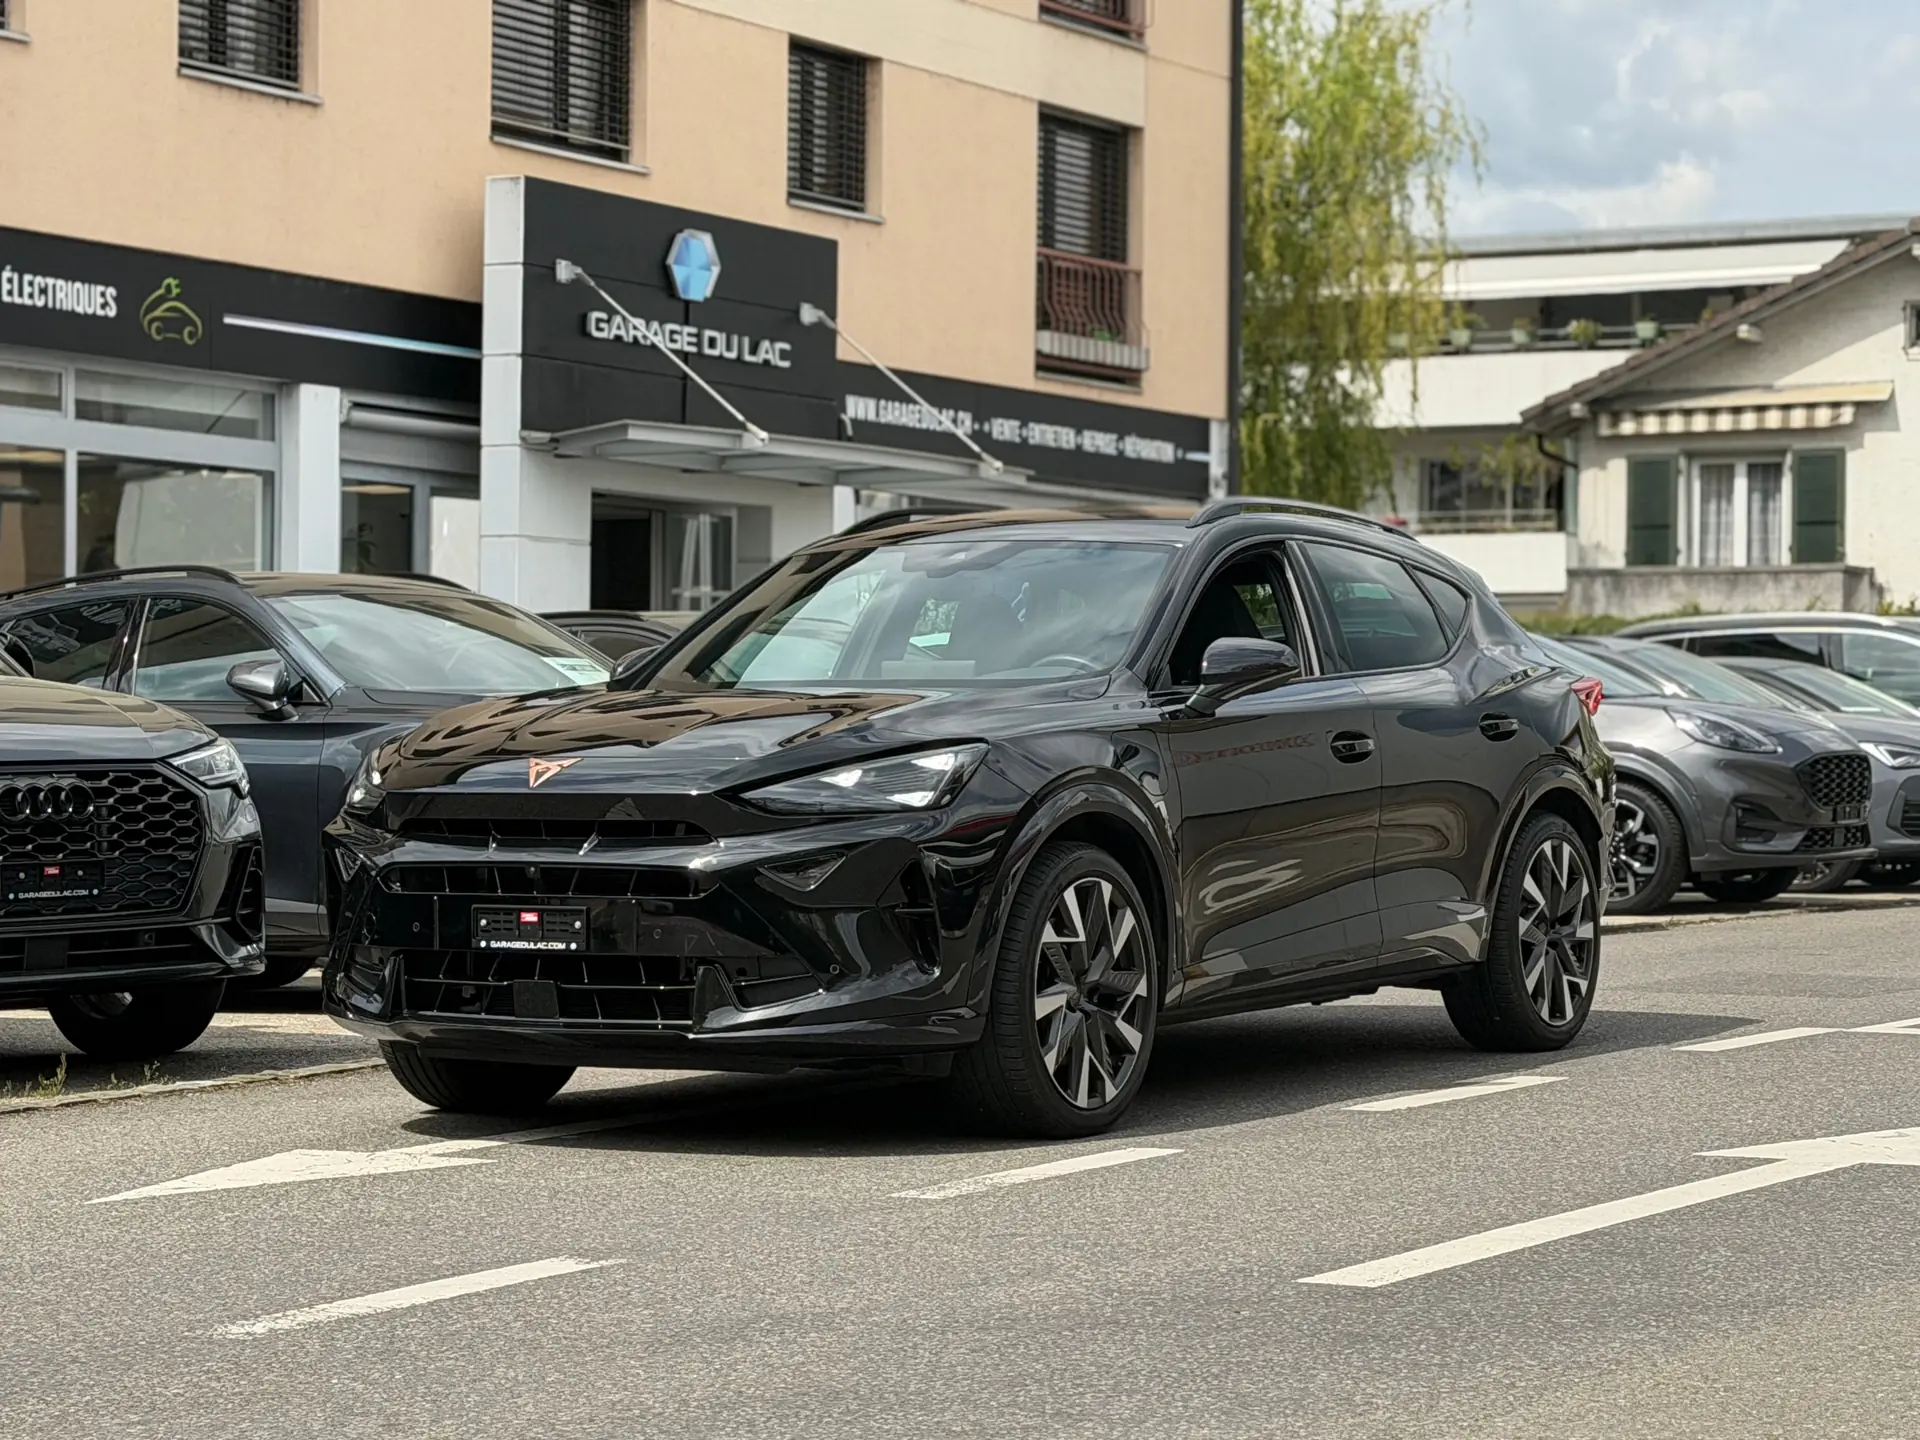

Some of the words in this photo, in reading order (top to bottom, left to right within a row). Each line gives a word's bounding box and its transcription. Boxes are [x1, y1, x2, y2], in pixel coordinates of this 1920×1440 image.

[1, 264, 118, 318] ÉLECTRIQUES
[586, 311, 699, 352] GARAGE
[702, 328, 739, 360] DU
[742, 335, 792, 368] LAC
[18, 889, 90, 899] GARAGEDULAC.COM
[490, 940, 567, 950] GARAGEDULAC.COM
